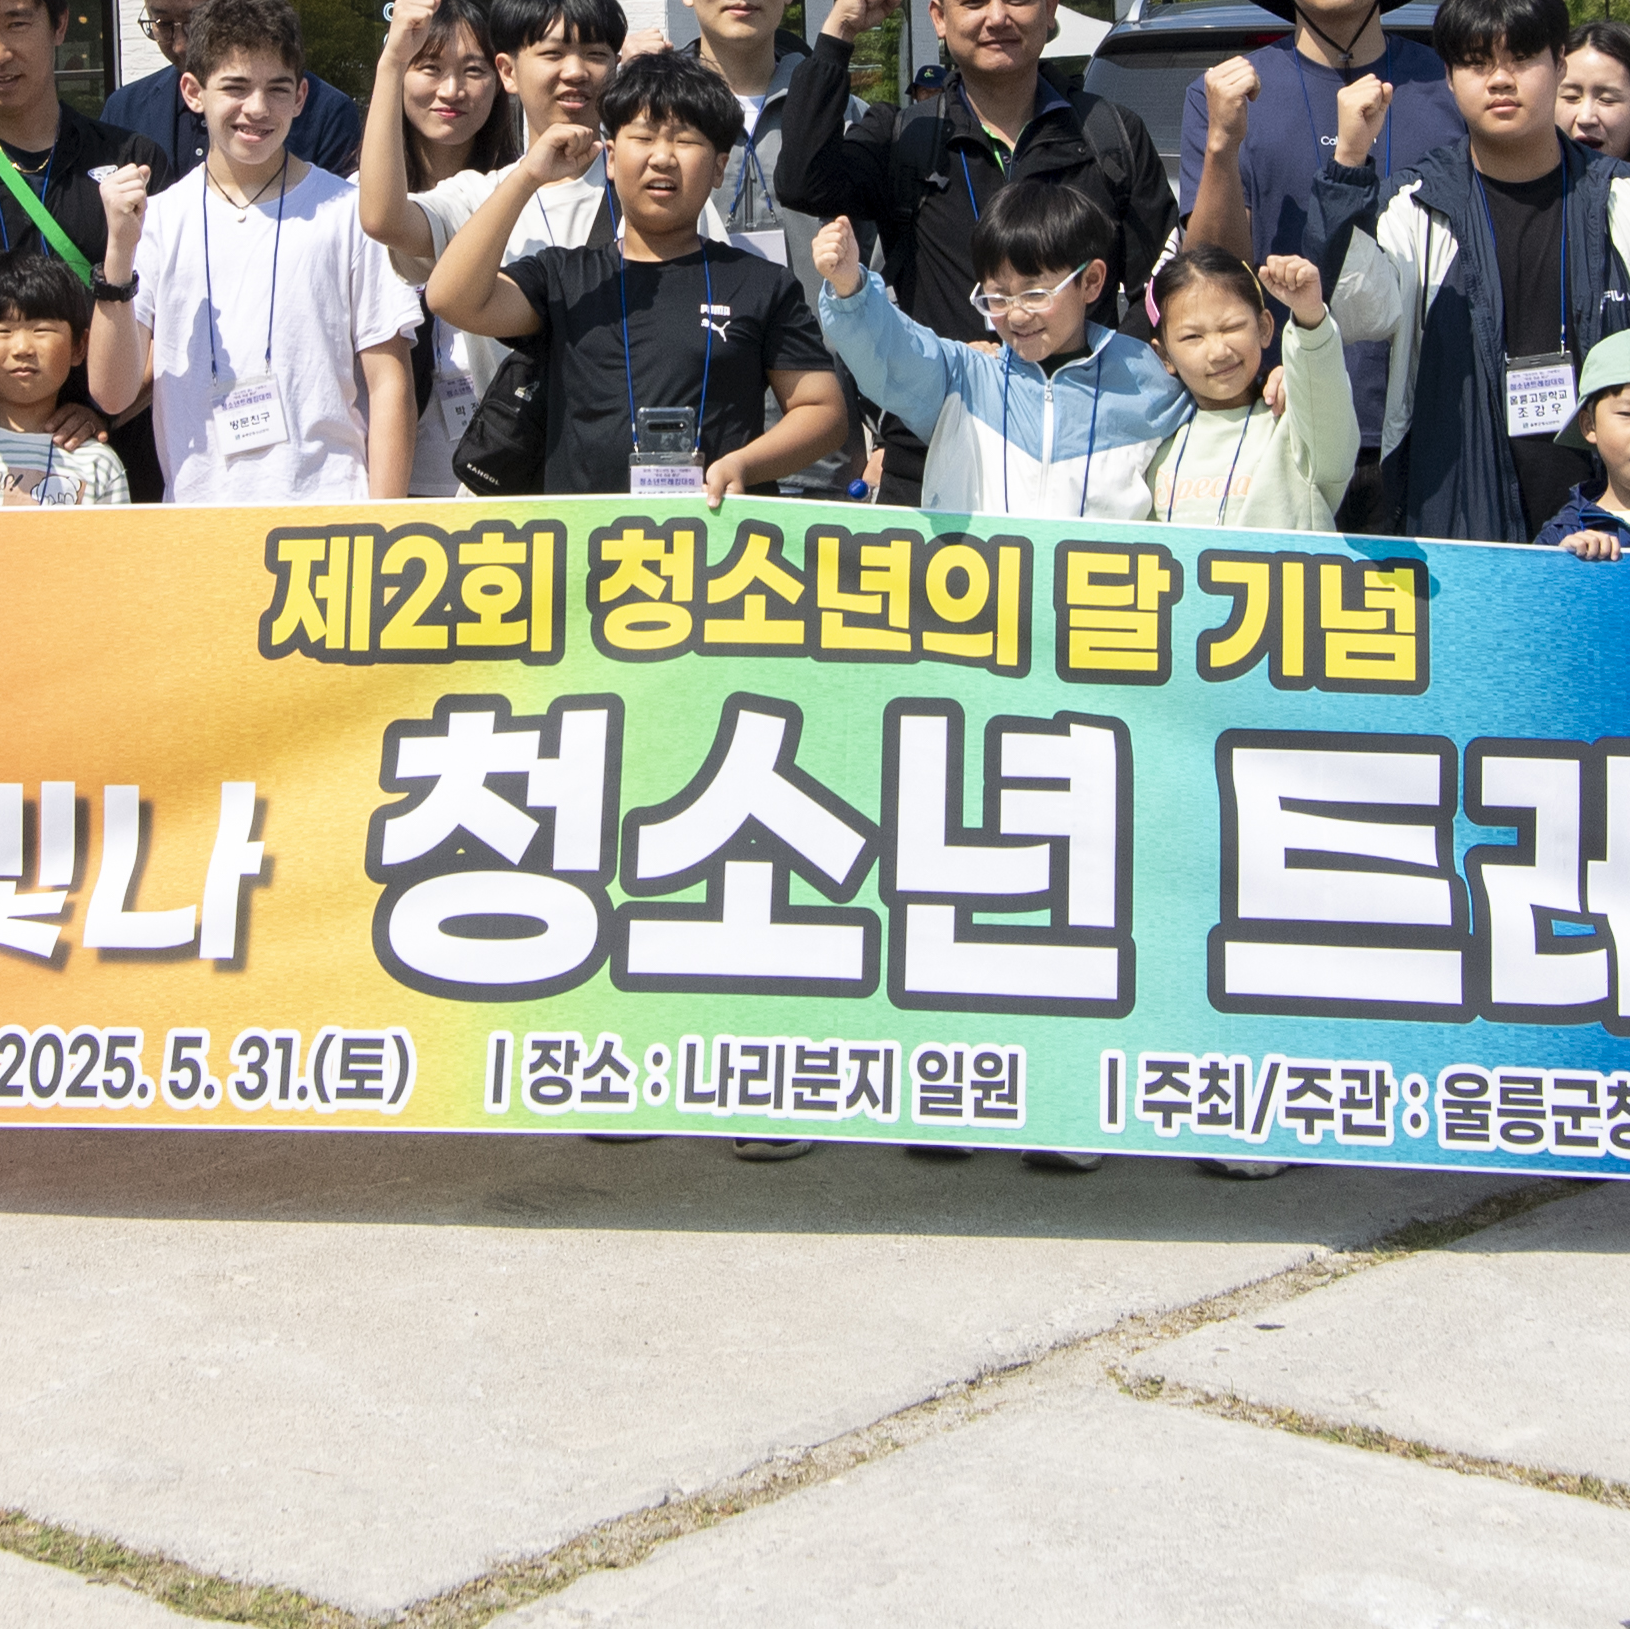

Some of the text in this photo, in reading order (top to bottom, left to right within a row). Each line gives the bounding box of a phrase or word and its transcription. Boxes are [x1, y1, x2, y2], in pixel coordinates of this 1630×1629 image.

[1510, 390, 1568, 406] 울릉고등학교
[466, 462, 501, 486] KANGOL
[269, 525, 1426, 690] 제2회 청소년의 달 기념
[376, 700, 1131, 1010] 청소년
[169, 1036, 216, 1101] 5.
[235, 1034, 410, 1106] 31.(토)
[529, 1039, 631, 1105] 장소
[683, 1042, 894, 1114] 나리분지
[916, 1050, 1019, 1120] 일원
[1142, 1061, 1389, 1136] 주최/주관
